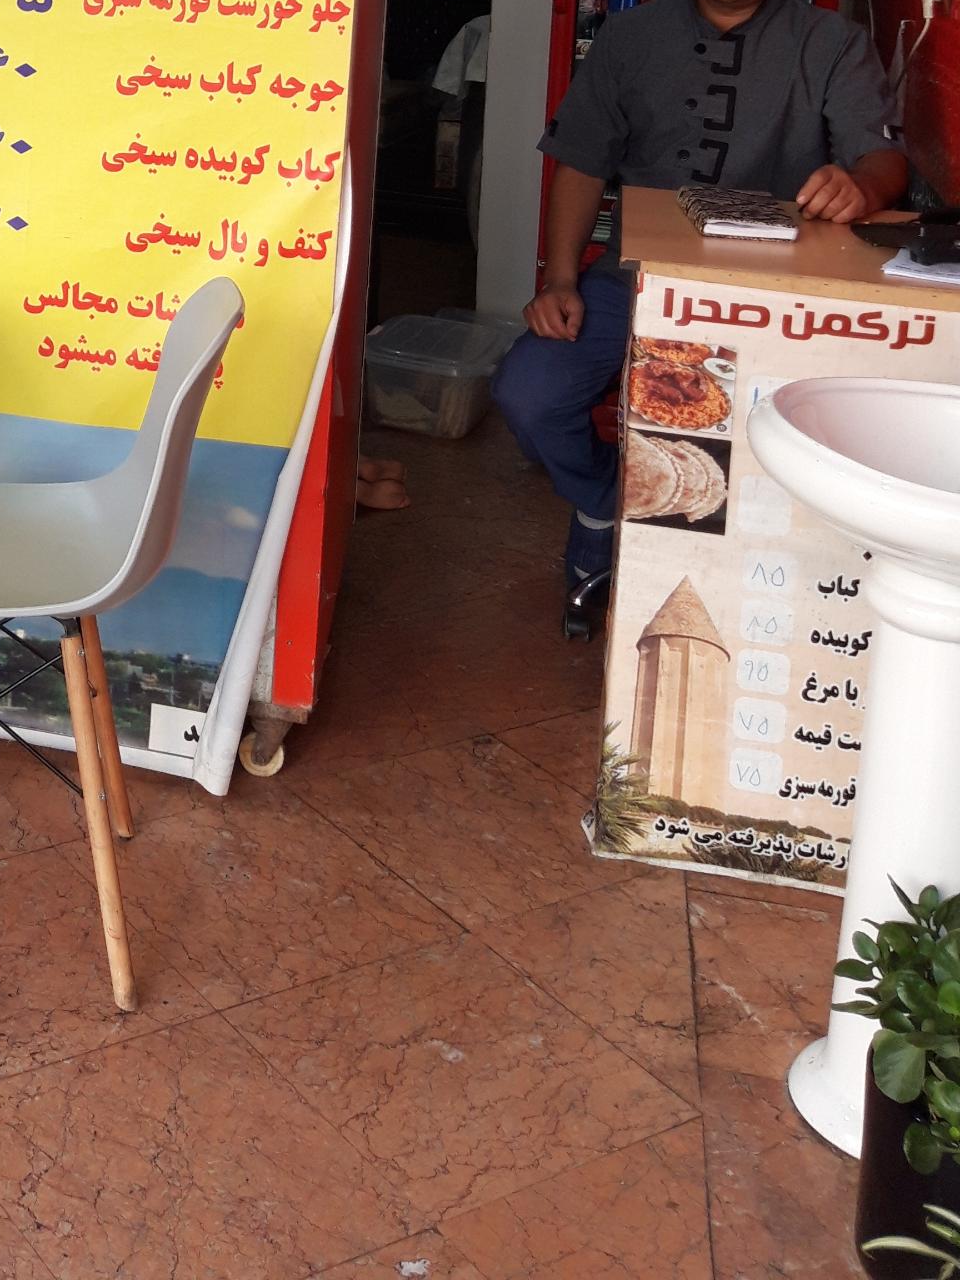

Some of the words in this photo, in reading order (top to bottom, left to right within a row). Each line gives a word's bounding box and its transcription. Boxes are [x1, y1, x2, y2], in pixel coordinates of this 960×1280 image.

[115, 54, 192, 99] سیخی
[199, 61, 262, 103] کباب
[269, 72, 344, 112] جوجه
[101, 132, 178, 174] سیخی
[185, 144, 271, 185] کوبیده
[277, 150, 342, 191] کباب
[124, 213, 201, 255] سیخی
[208, 219, 248, 263] بال
[256, 234, 269, 267] و
[277, 229, 332, 260] کتف
[23, 281, 118, 320] مجالس
[663, 288, 771, 329] صحرا
[782, 302, 936, 350] ترکمن
[38, 335, 116, 372] میشود
[817, 575, 860, 602] کباب
[811, 630, 873, 657] کوبیده
[801, 672, 839, 703] مرغ
[845, 679, 858, 708] با
[794, 724, 832, 751] قیمه
[779, 776, 816, 800] سبزی
[818, 778, 856, 806] قورمه
[654, 818, 690, 837] شود
[694, 830, 723, 847] می
[728, 830, 794, 862] پذیرفته
